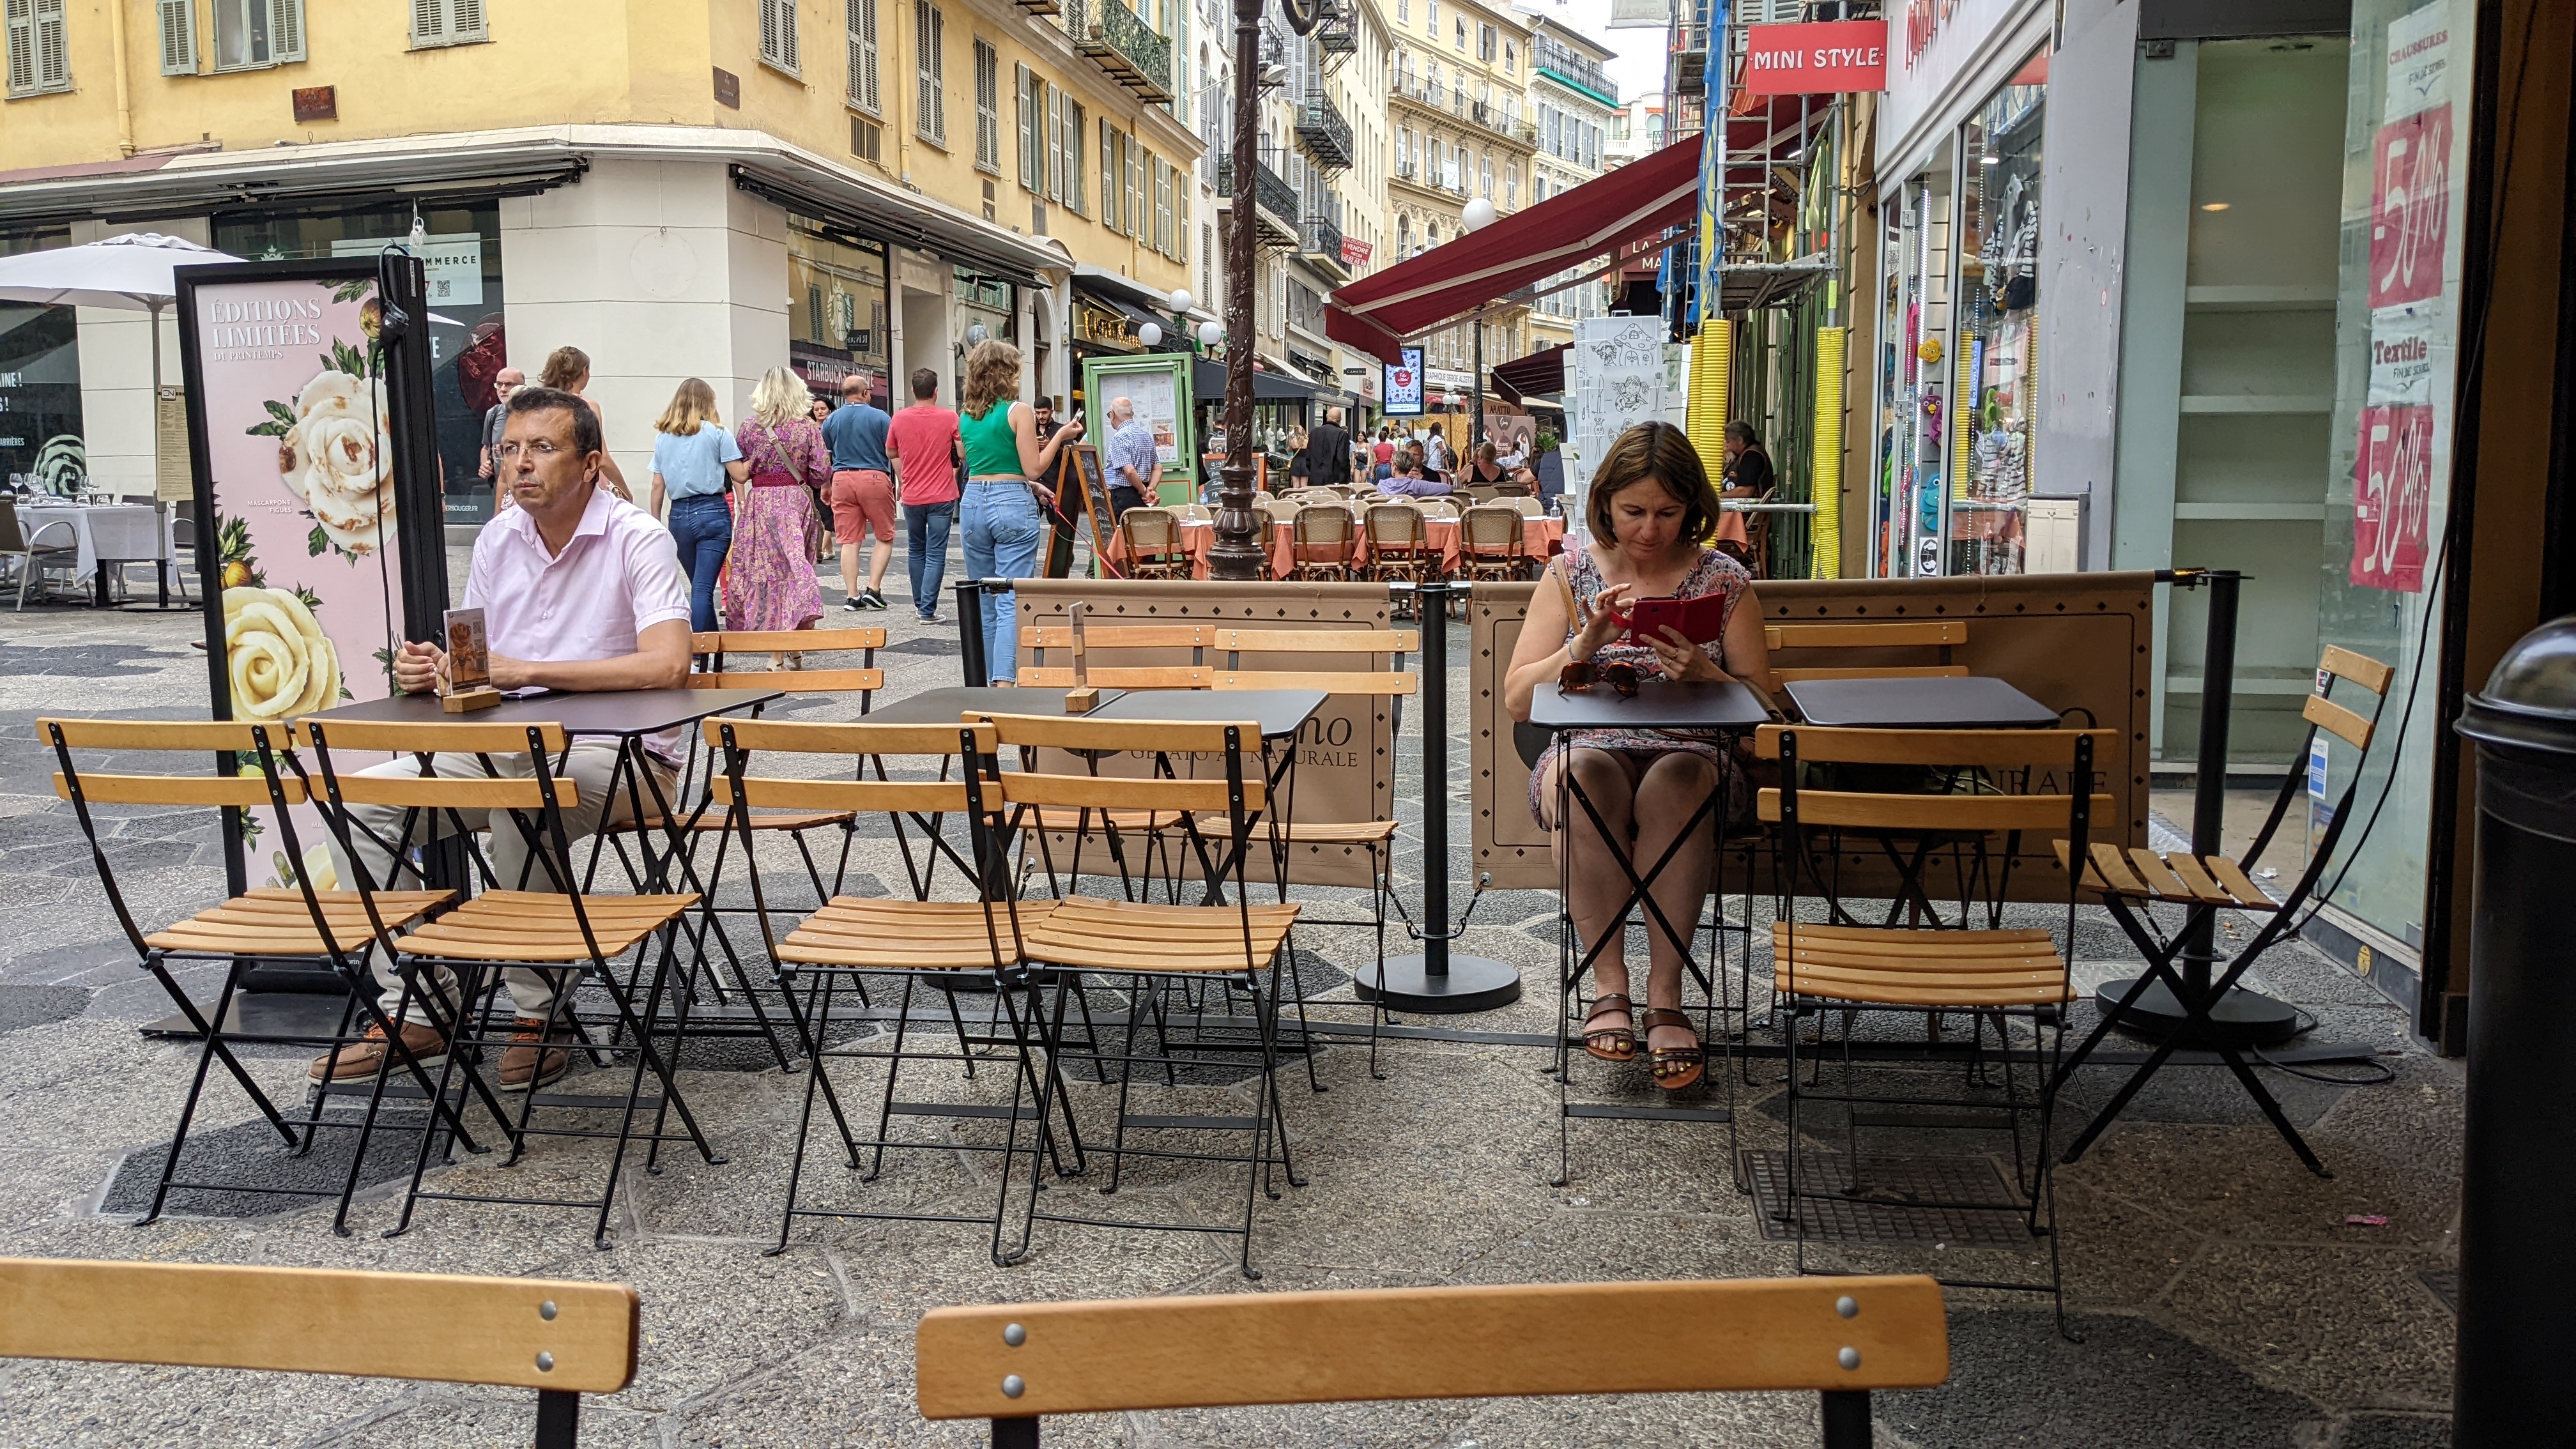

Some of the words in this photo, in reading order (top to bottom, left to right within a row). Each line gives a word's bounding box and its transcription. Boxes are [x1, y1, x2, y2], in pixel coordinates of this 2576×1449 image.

[1754, 51, 1804, 70] MINI
[1814, 47, 1880, 68] STYLE
[1347, 243, 1369, 255] VENDRE
[425, 255, 477, 266] MMERCE
[211, 298, 322, 324] ÉDITIONS
[213, 319, 321, 349] LIMITÉES
[230, 349, 284, 361] PRINTEMPS
[2373, 335, 2427, 365] Textile
[1446, 374, 1459, 382] SERGE
[1131, 750, 1209, 761] GEATO
